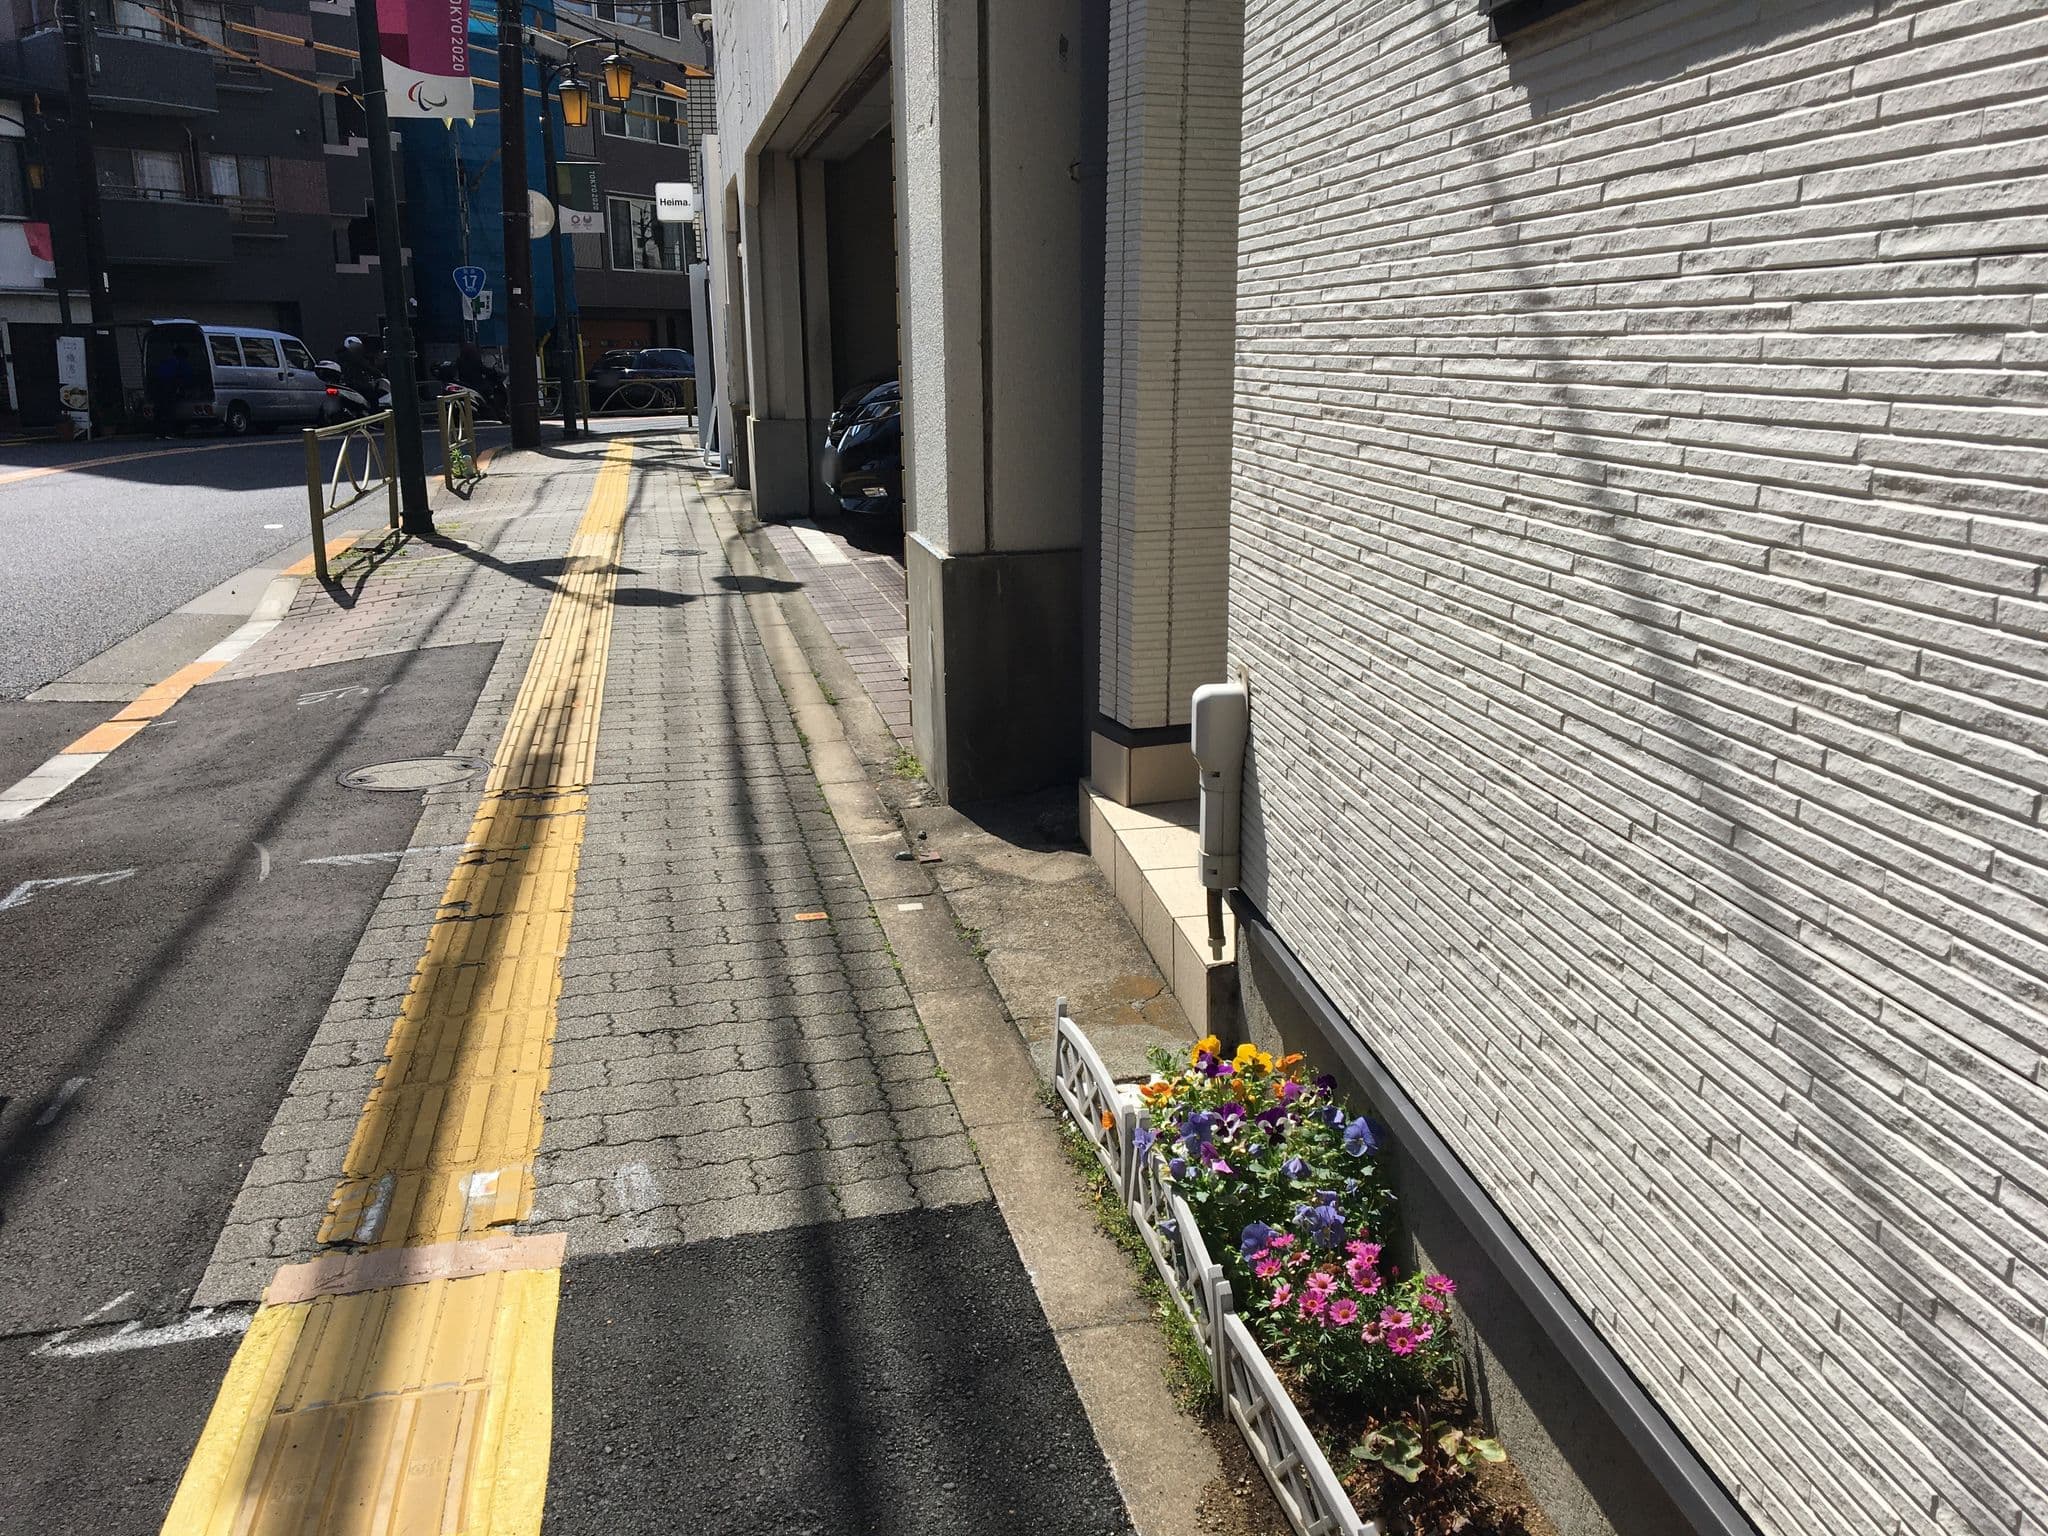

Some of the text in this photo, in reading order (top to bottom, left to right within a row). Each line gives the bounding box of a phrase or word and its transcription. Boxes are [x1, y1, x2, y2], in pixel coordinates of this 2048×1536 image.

[450, 36, 465, 71] 2020
[588, 171, 598, 193] TOKYO
[659, 198, 691, 207] Heima.
[462, 275, 478, 288] 17
